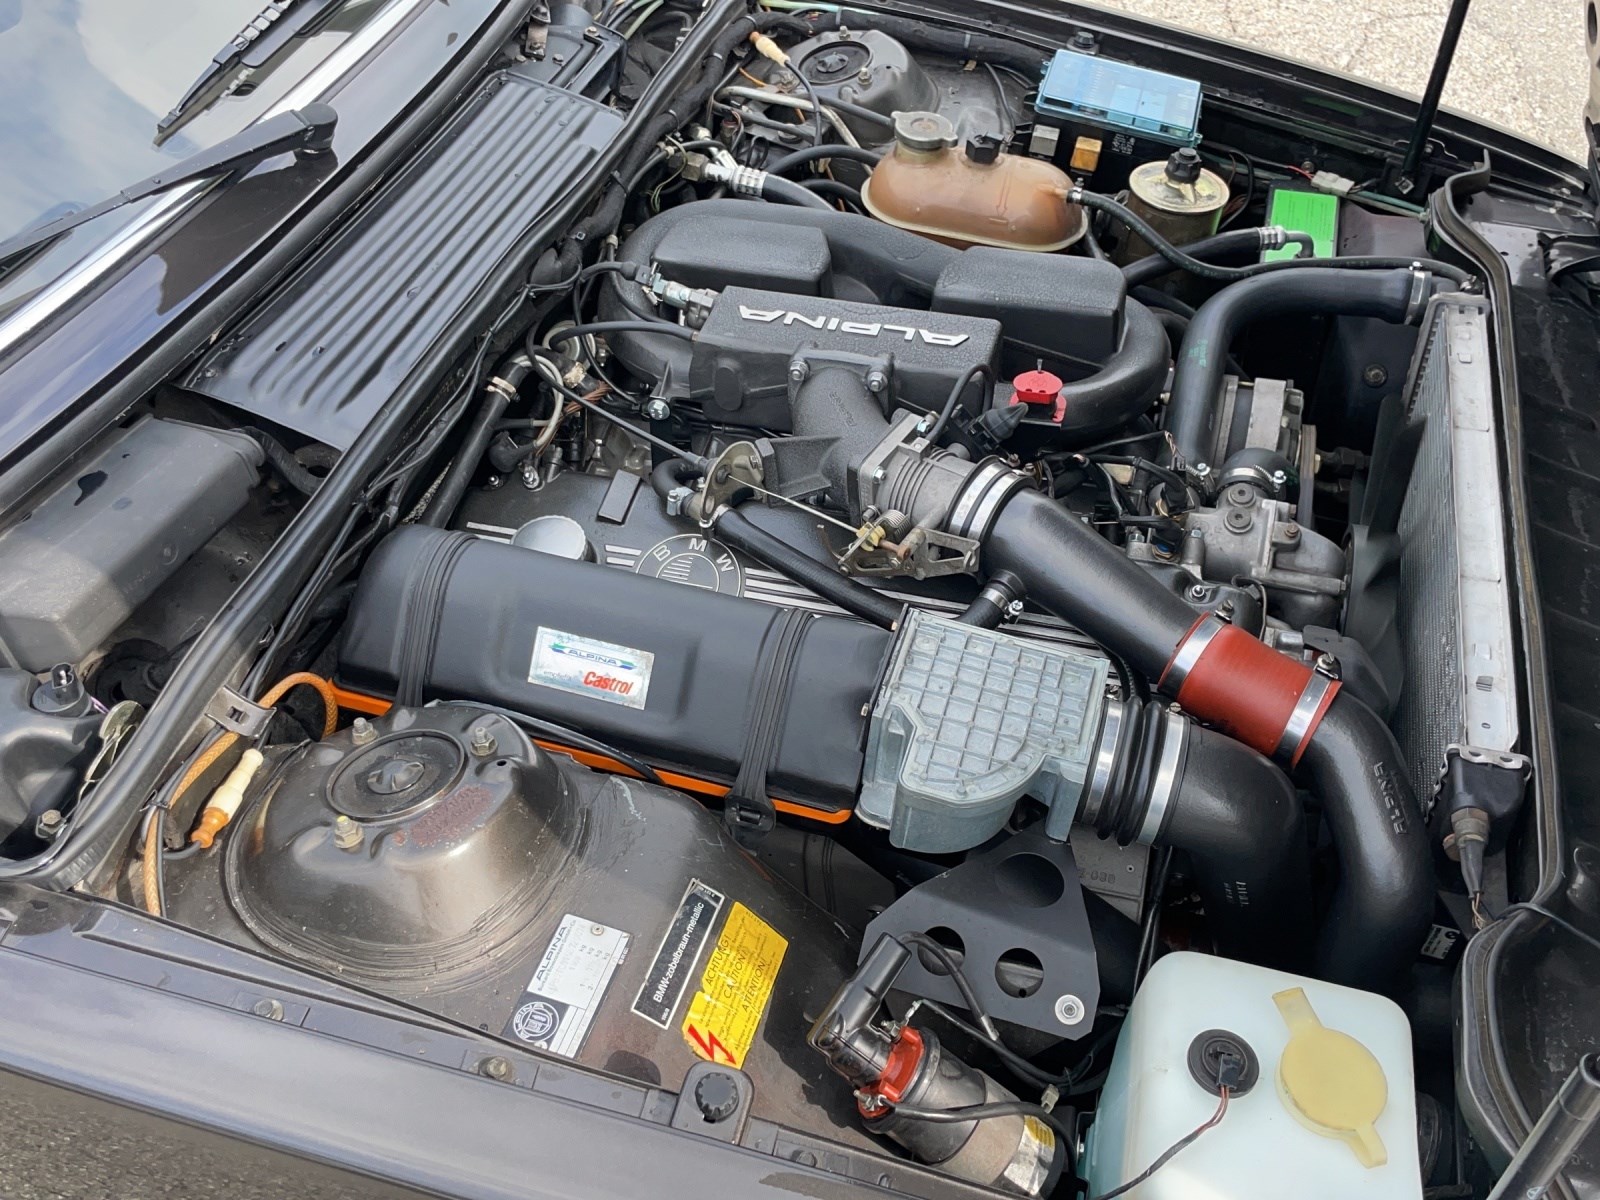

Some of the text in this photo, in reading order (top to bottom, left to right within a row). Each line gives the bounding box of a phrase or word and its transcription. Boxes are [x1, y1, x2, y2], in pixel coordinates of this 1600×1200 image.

[739, 305, 970, 347] ALPINA
[653, 538, 735, 572] BMW
[568, 649, 617, 665] ALPINA
[583, 671, 634, 695] Castrol
[535, 925, 567, 980] ALPINA
[652, 901, 704, 1002] BMW-zobelbraun-metallic
[702, 934, 731, 986] ACHTUNG!
[722, 949, 748, 999] CAUTION!
[739, 957, 767, 1011] ATTENTION!
